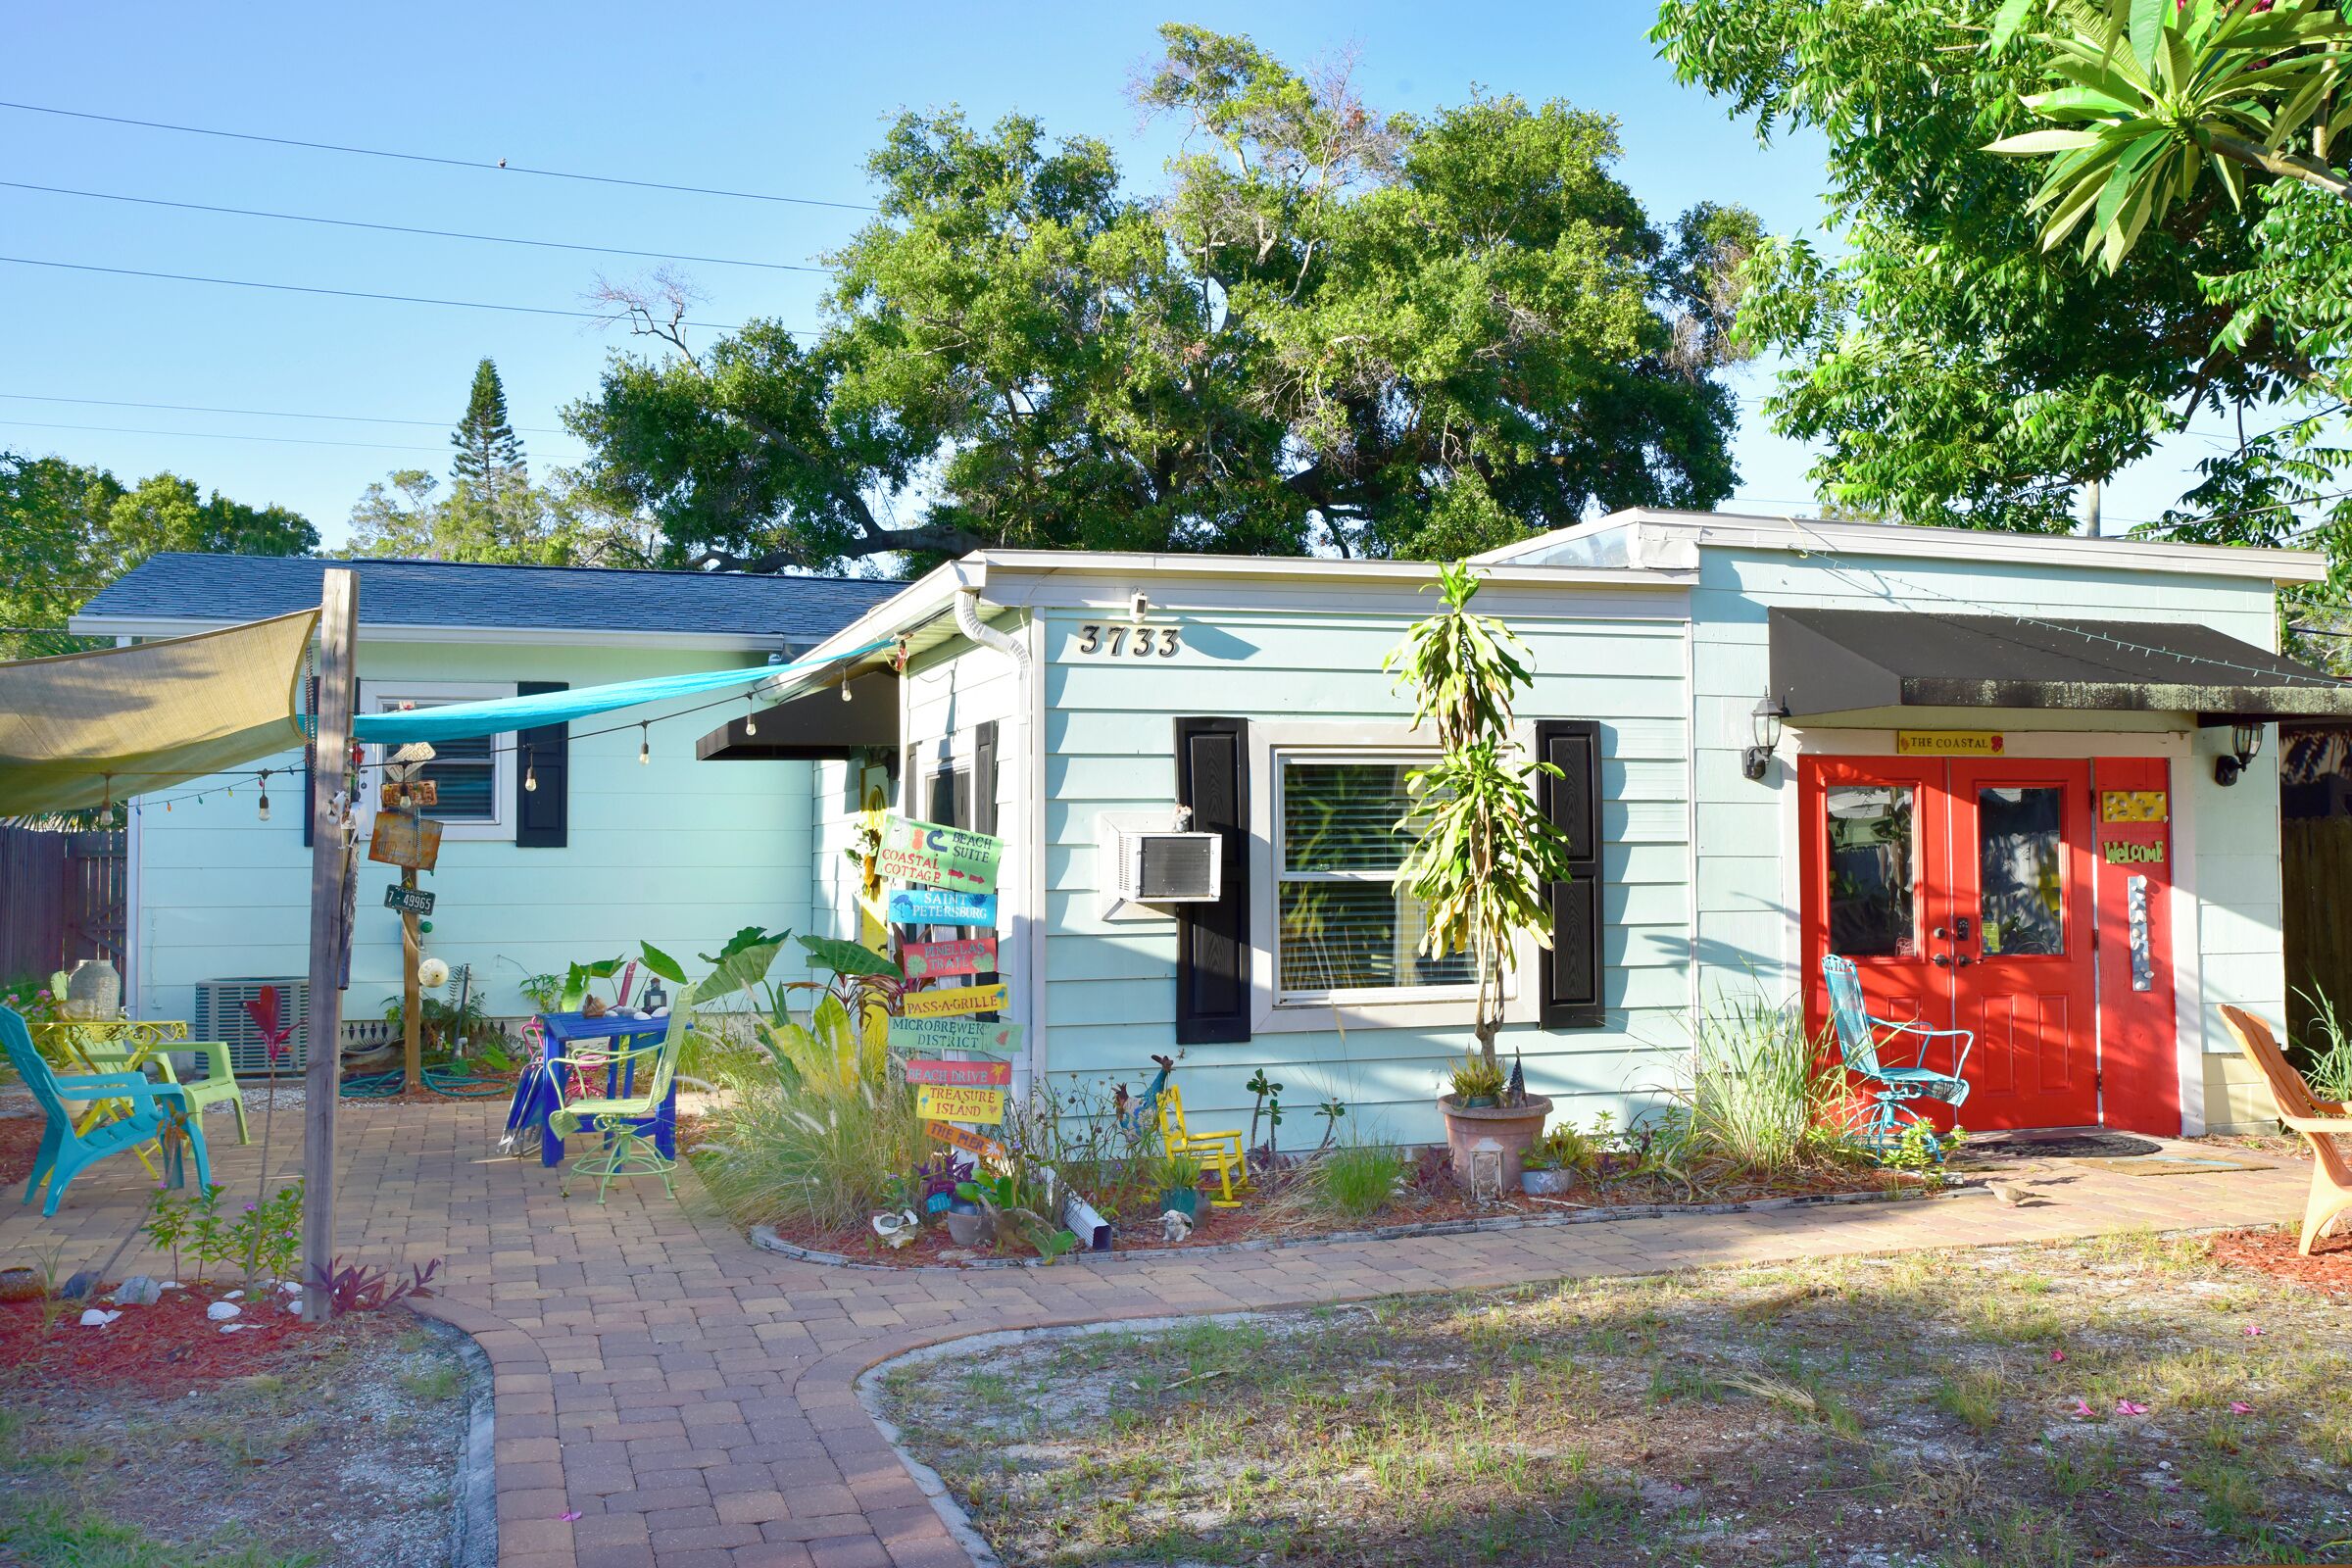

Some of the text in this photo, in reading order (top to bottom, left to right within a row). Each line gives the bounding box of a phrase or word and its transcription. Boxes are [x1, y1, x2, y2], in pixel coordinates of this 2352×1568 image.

[1080, 624, 1182, 658] 3733
[1911, 737, 1988, 749] THE COASTAL
[953, 831, 993, 850] BEACH
[882, 848, 940, 870] COASTAL
[953, 846, 990, 863] SUITE
[884, 862, 942, 884] COTTAGE
[403, 894, 432, 909] 49965
[924, 893, 968, 906] SAINT
[912, 905, 988, 918] PETERSBURG
[924, 943, 986, 957] PINELLAS
[930, 956, 969, 970] TRAIL
[917, 1034, 979, 1048] DISTRICT
[908, 1068, 989, 1083] BEACH DRIVE
[930, 1087, 996, 1103] TREASURE
[936, 1102, 981, 1117] ISLAND
[930, 1123, 985, 1152] THE PIER
